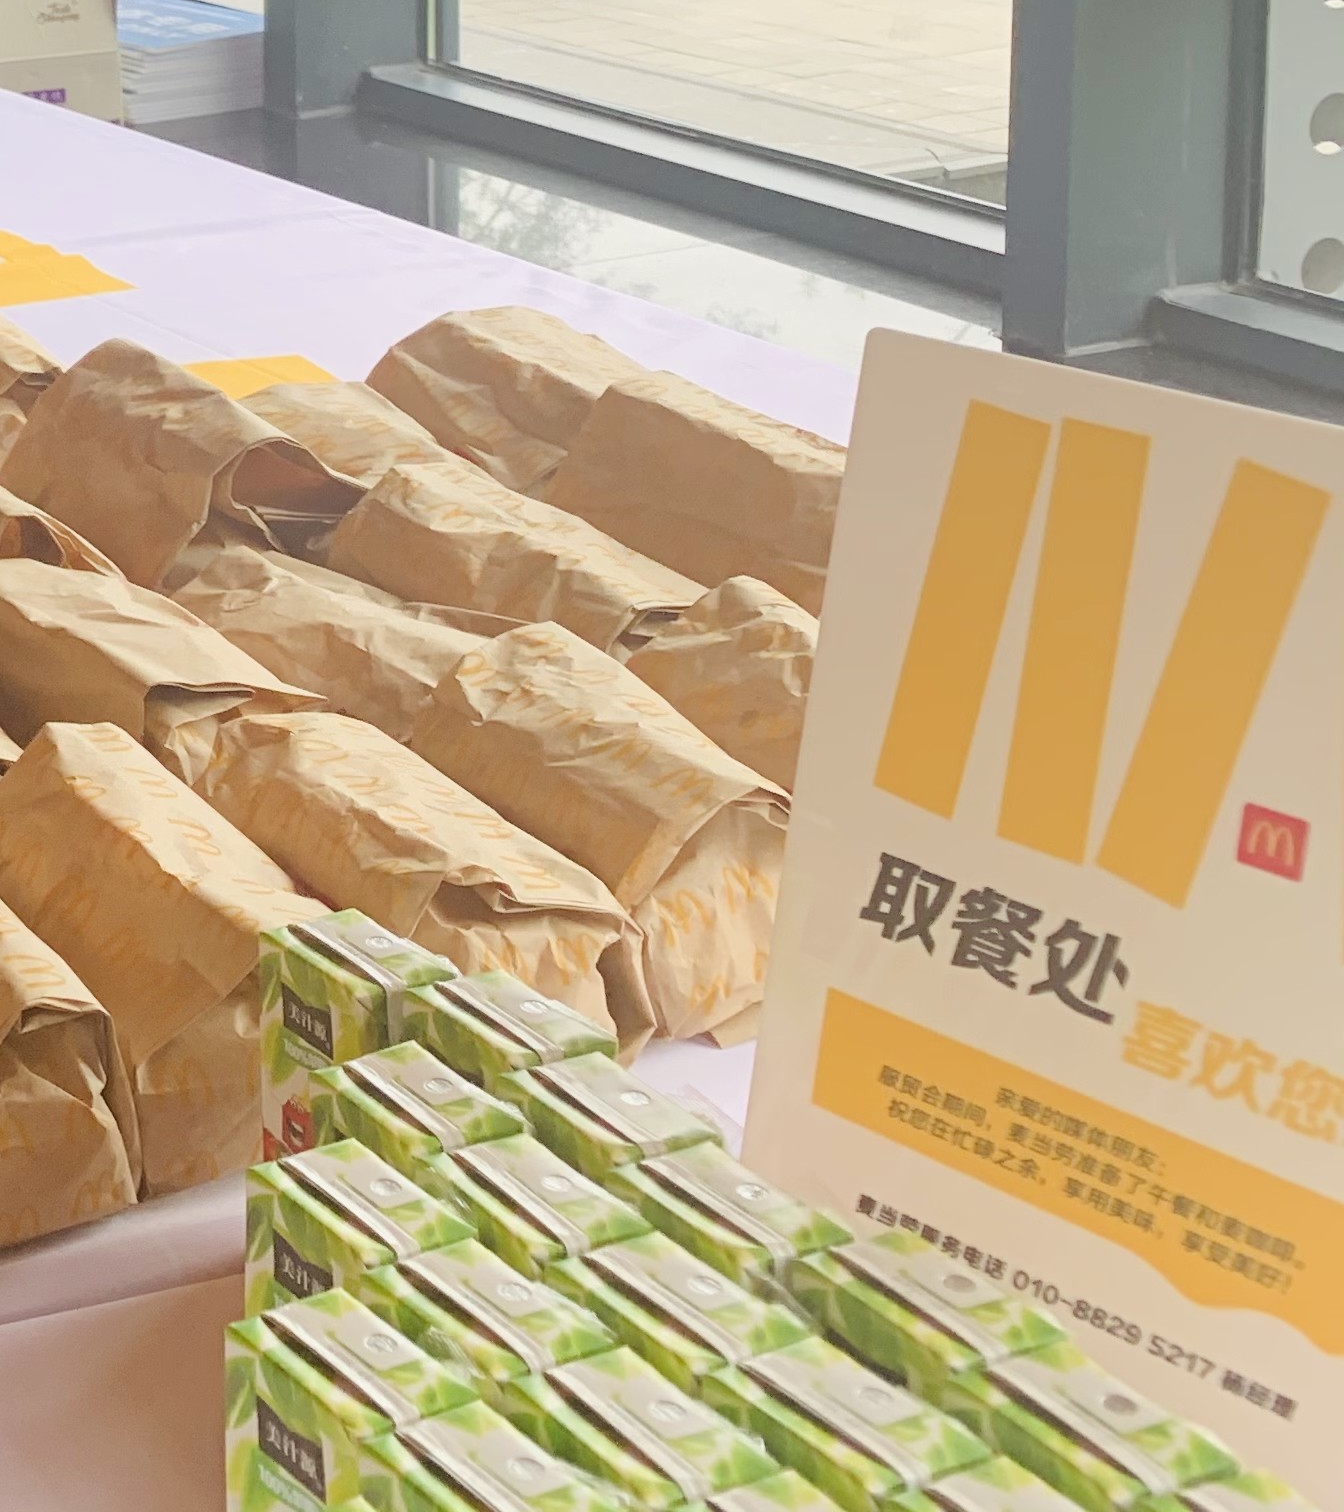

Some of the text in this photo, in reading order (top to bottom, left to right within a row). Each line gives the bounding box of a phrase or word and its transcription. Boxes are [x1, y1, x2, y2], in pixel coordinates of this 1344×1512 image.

[859, 851, 1131, 1026] 取餐处
[1012, 1269, 1143, 1346] 010-8829
[1148, 1333, 1216, 1380] 5217
